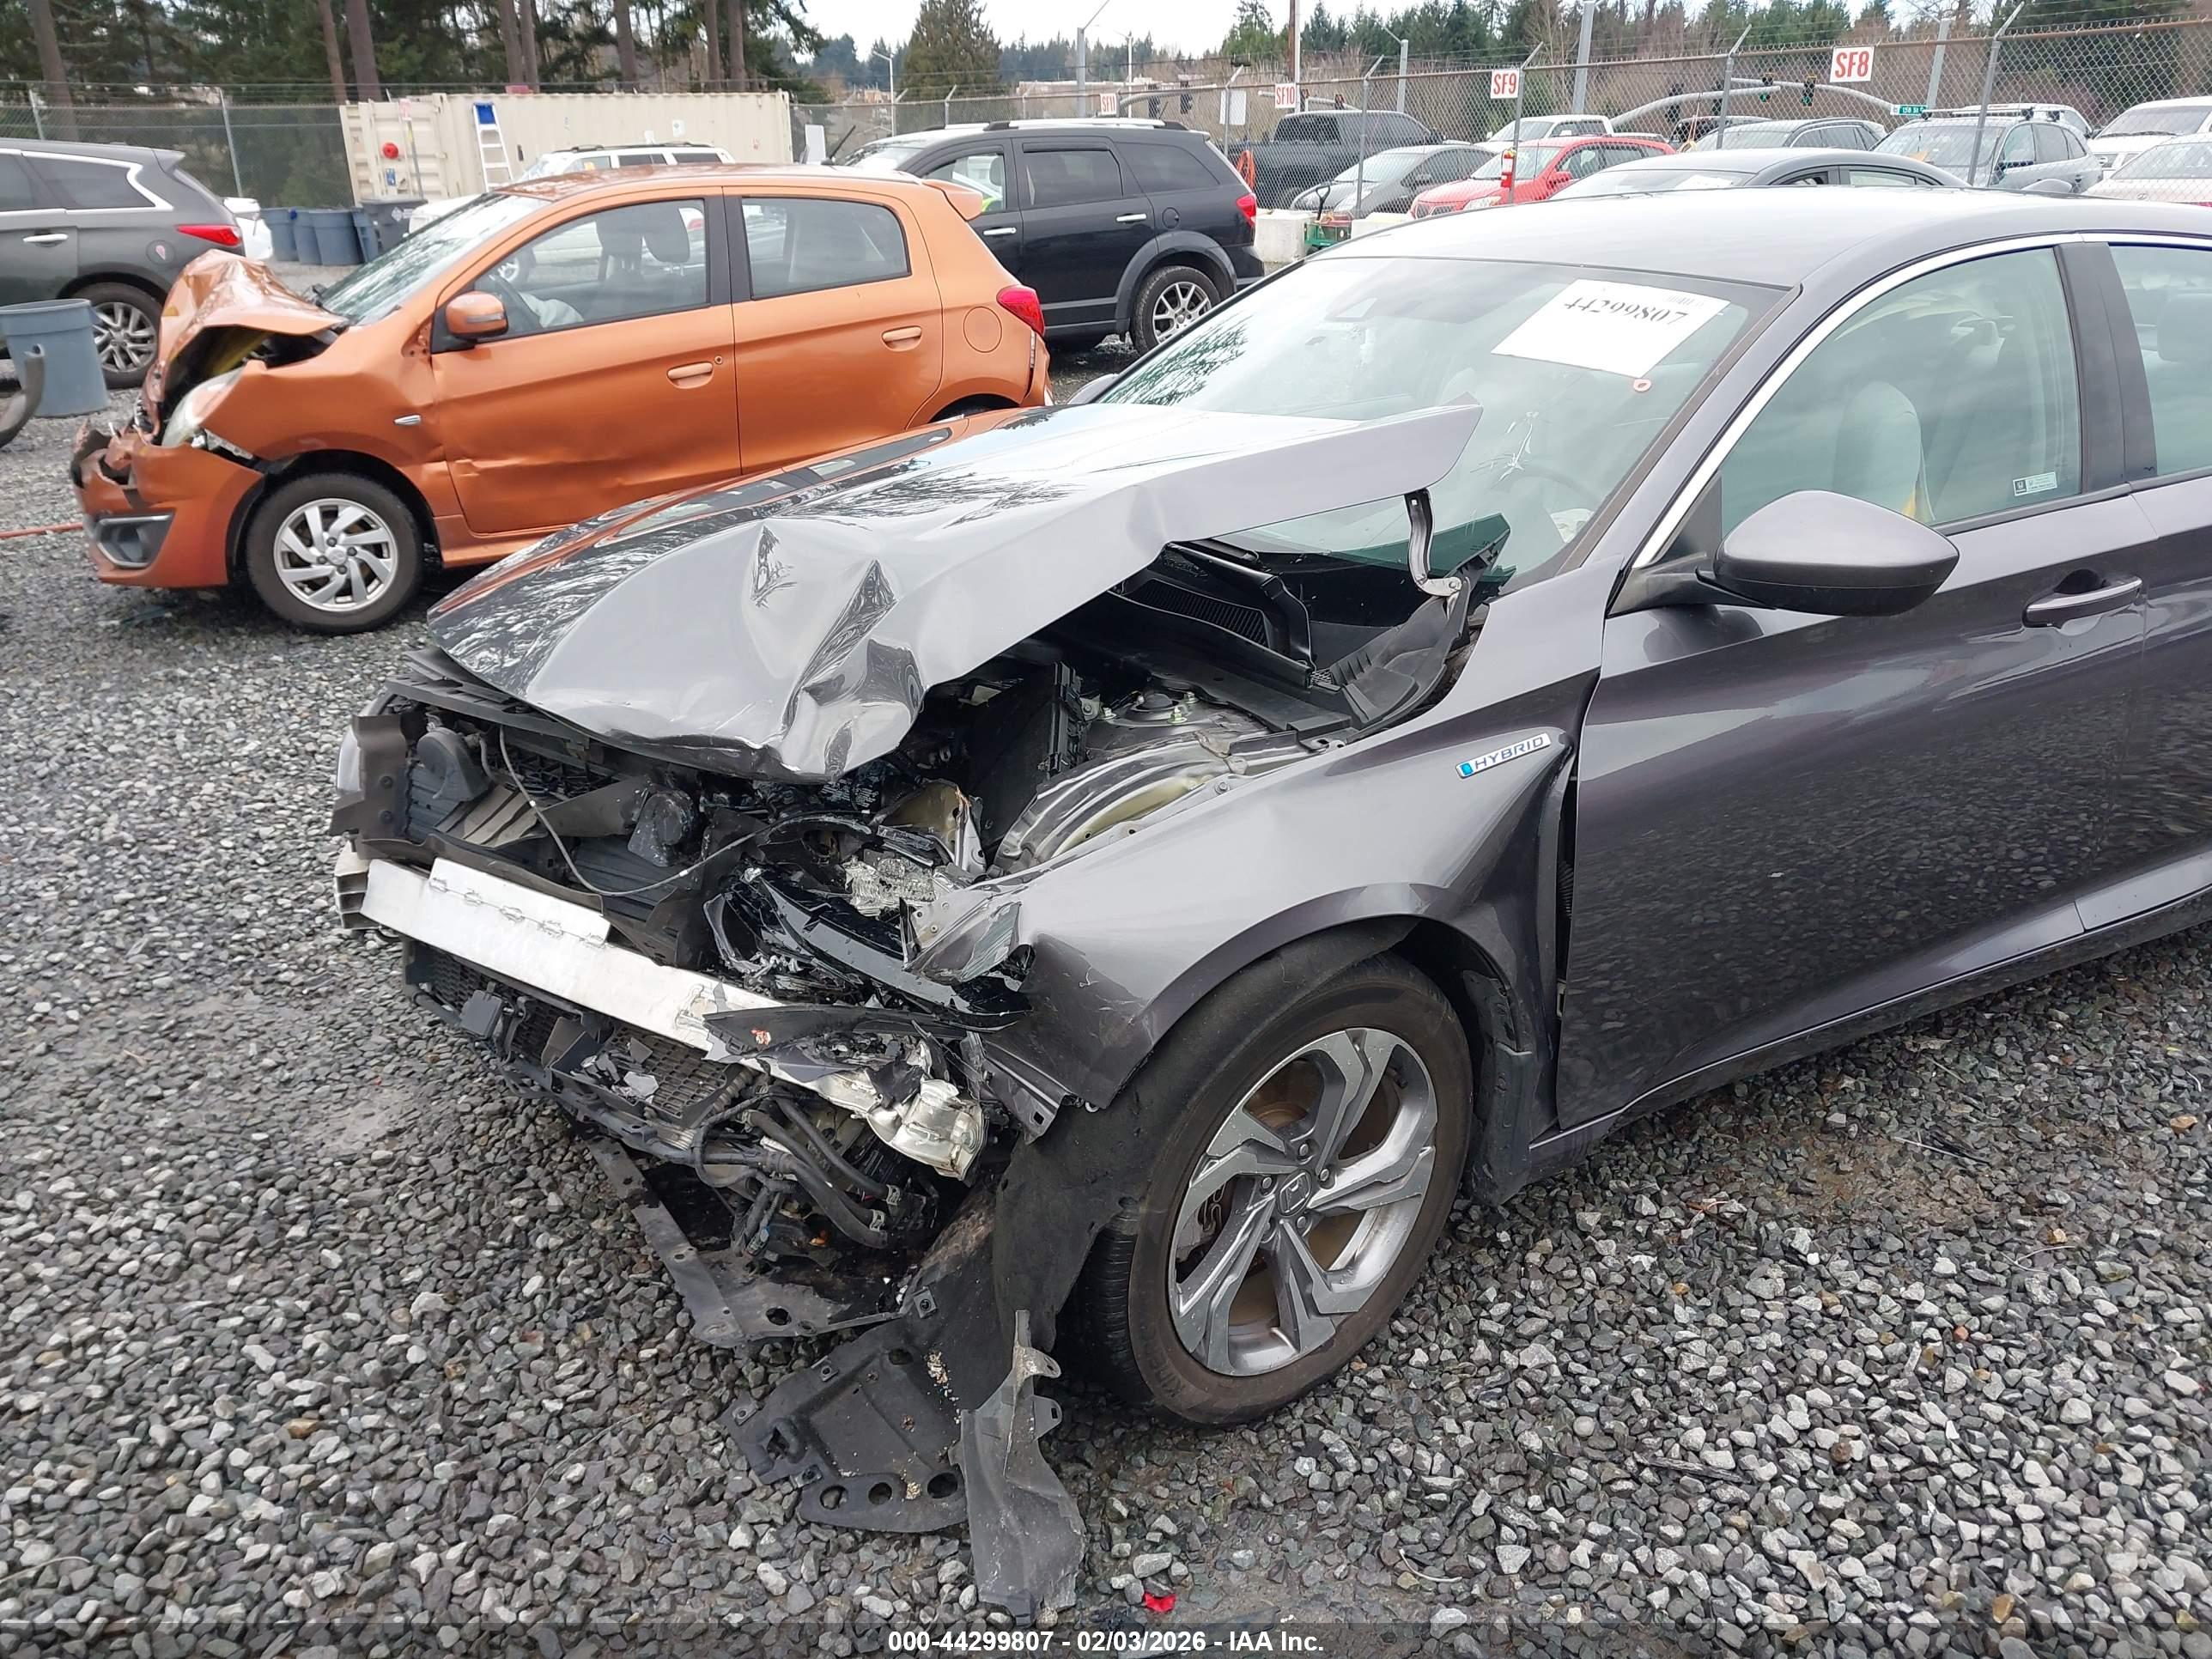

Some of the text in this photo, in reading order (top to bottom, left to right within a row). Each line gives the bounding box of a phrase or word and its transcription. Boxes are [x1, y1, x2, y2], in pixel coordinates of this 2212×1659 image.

[1835, 51, 1869, 78] SF8
[1276, 86, 1295, 105] SF10
[1493, 73, 1516, 94] SF9
[1102, 95, 1115, 112] SF11
[1564, 297, 1690, 325] 44299807
[1474, 737, 1544, 769] HYBRID
